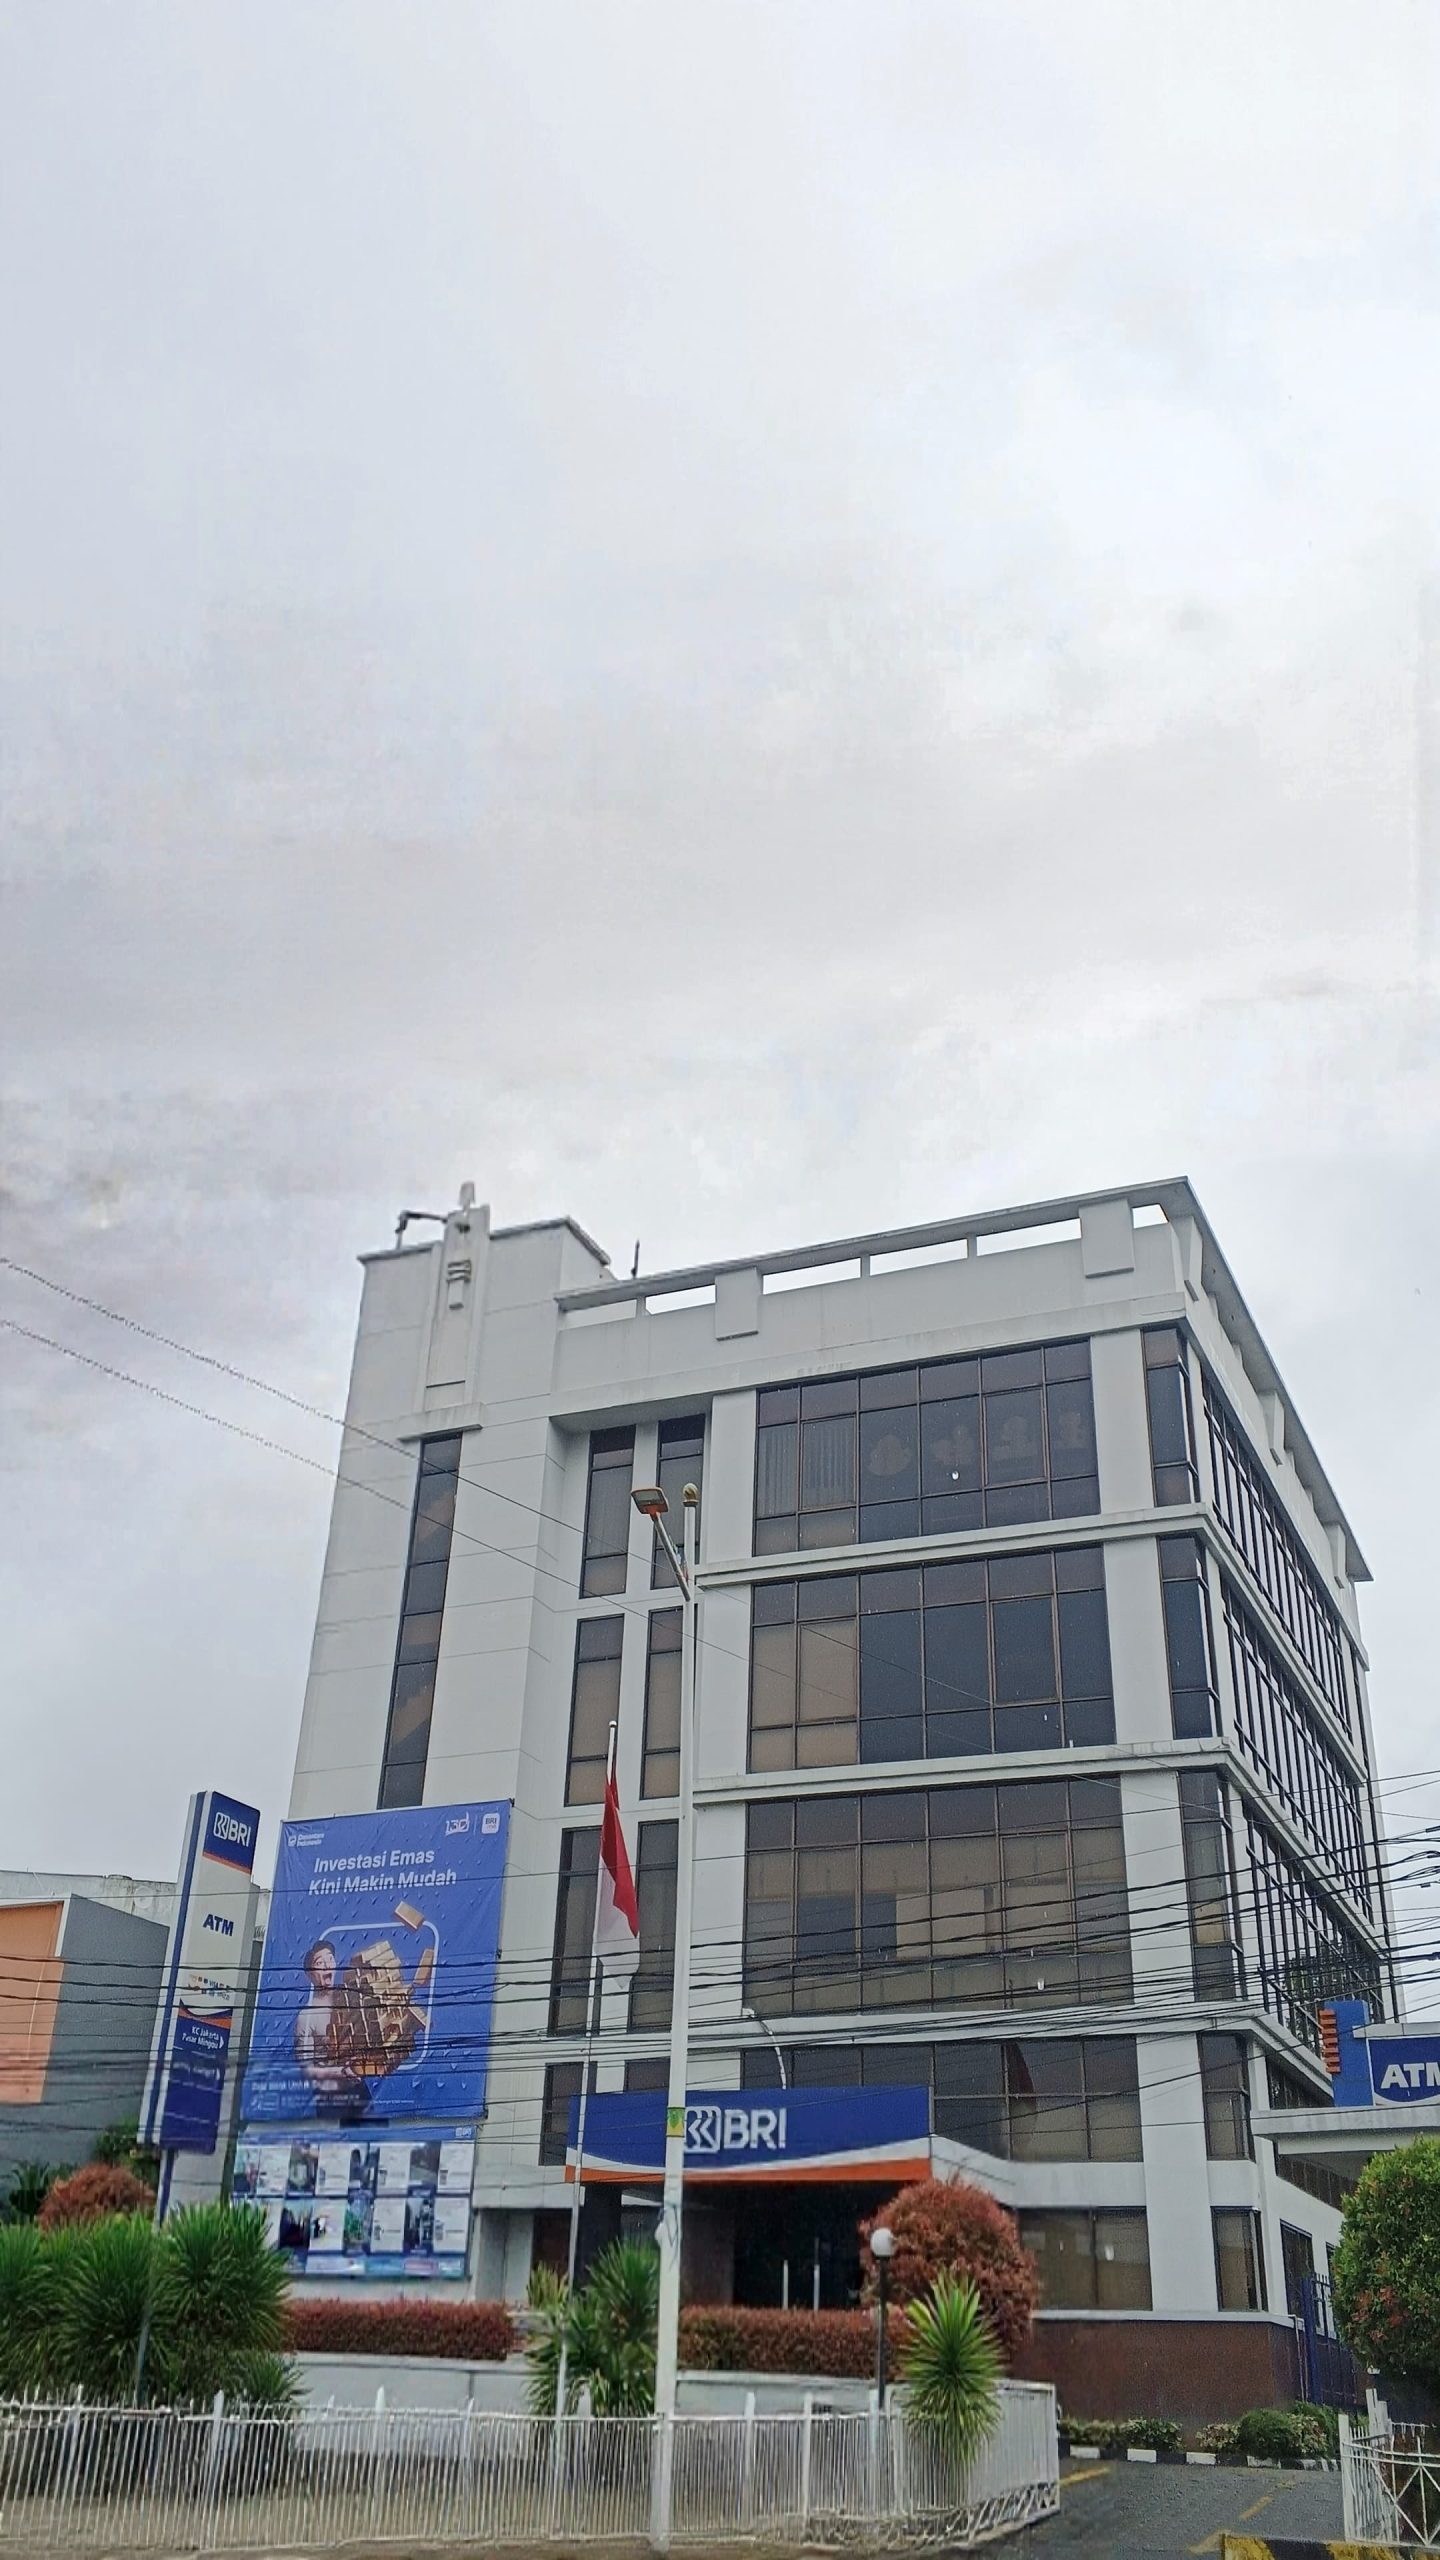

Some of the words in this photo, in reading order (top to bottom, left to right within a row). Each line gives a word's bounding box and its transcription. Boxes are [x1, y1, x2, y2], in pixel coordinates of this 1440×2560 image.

[228, 1818, 252, 1847] BRI
[314, 1850, 386, 1873] Investasi
[389, 1849, 435, 1868] Emas
[308, 1876, 341, 1896] Kini
[343, 1873, 394, 1893] Makin
[398, 1868, 457, 1889] Mudah
[203, 1913, 234, 1936] ATM
[723, 2107, 787, 2150] BRI
